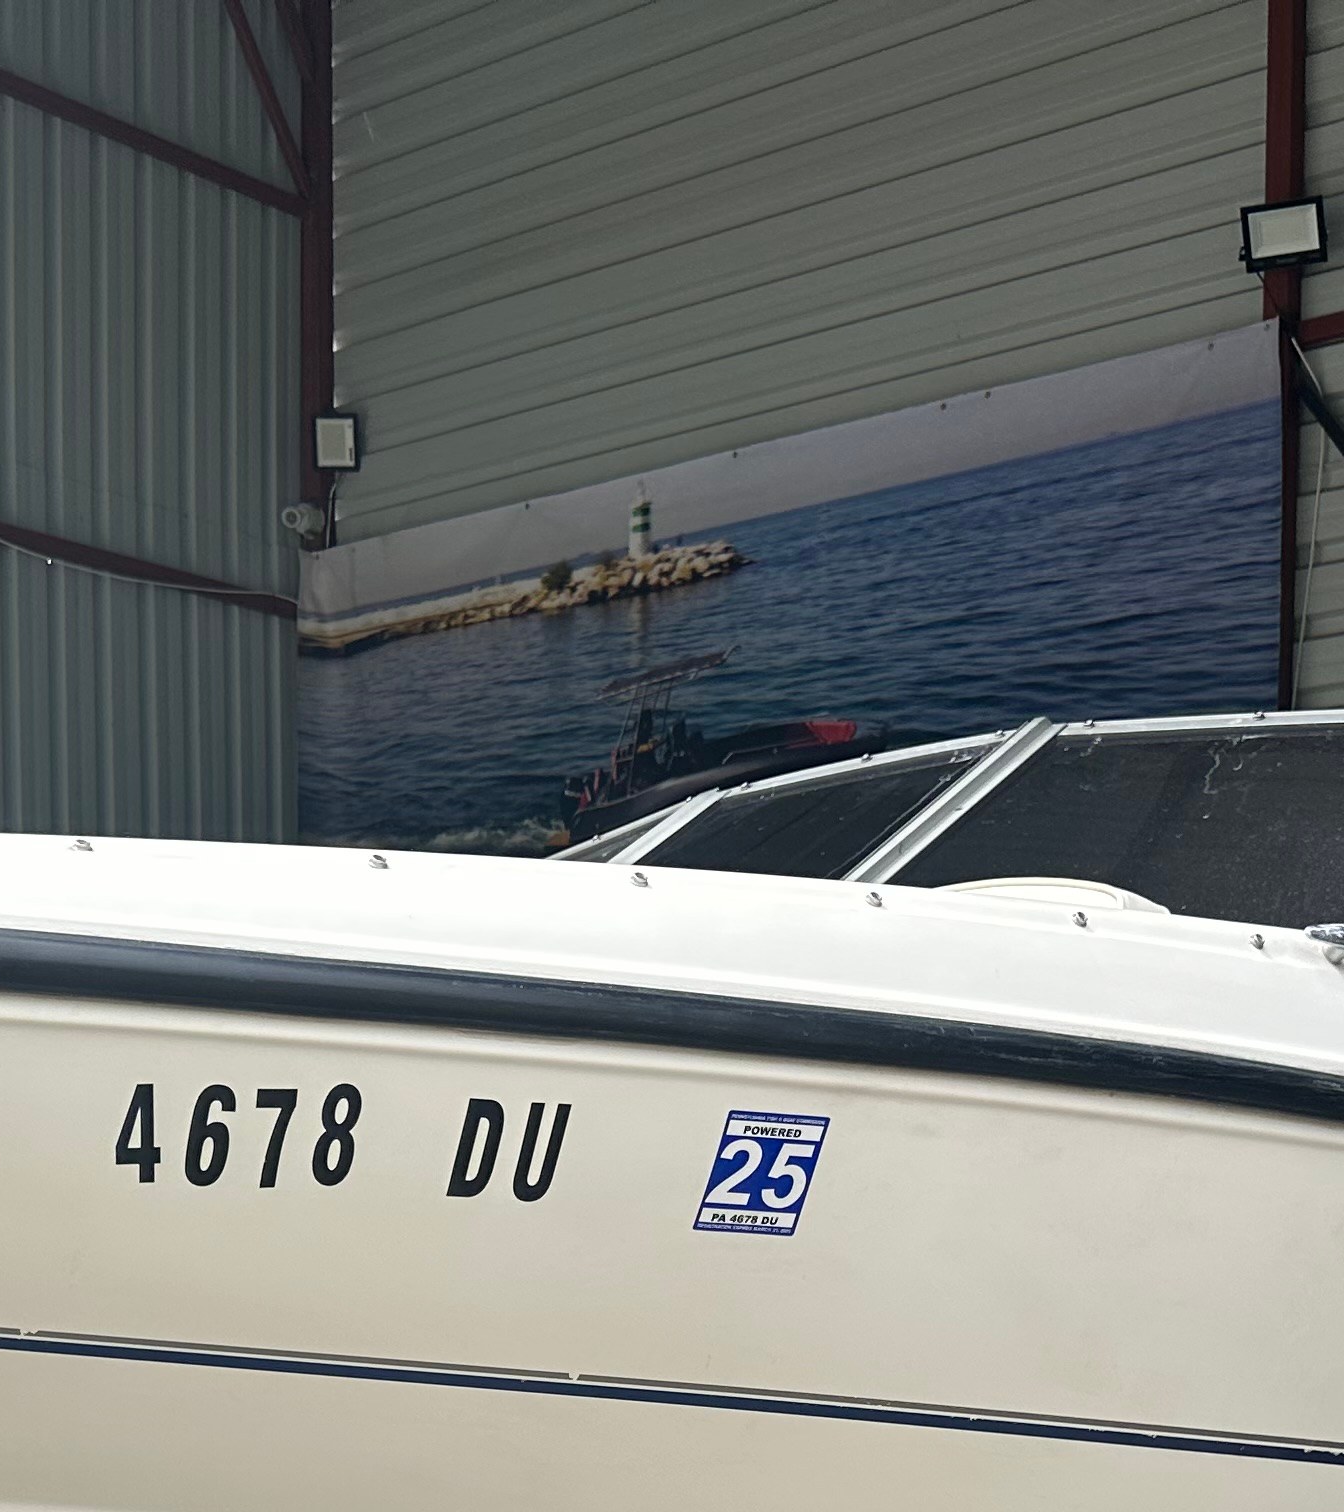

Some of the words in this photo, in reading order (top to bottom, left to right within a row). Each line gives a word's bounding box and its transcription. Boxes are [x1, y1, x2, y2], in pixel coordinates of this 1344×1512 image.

[114, 1083, 362, 1188] 4678
[446, 1097, 572, 1202] DU
[743, 1125, 802, 1138] POWERED
[704, 1138, 816, 1209] 25
[710, 1213, 726, 1222] PA
[729, 1213, 759, 1225] 4678
[760, 1215, 779, 1226] DU
